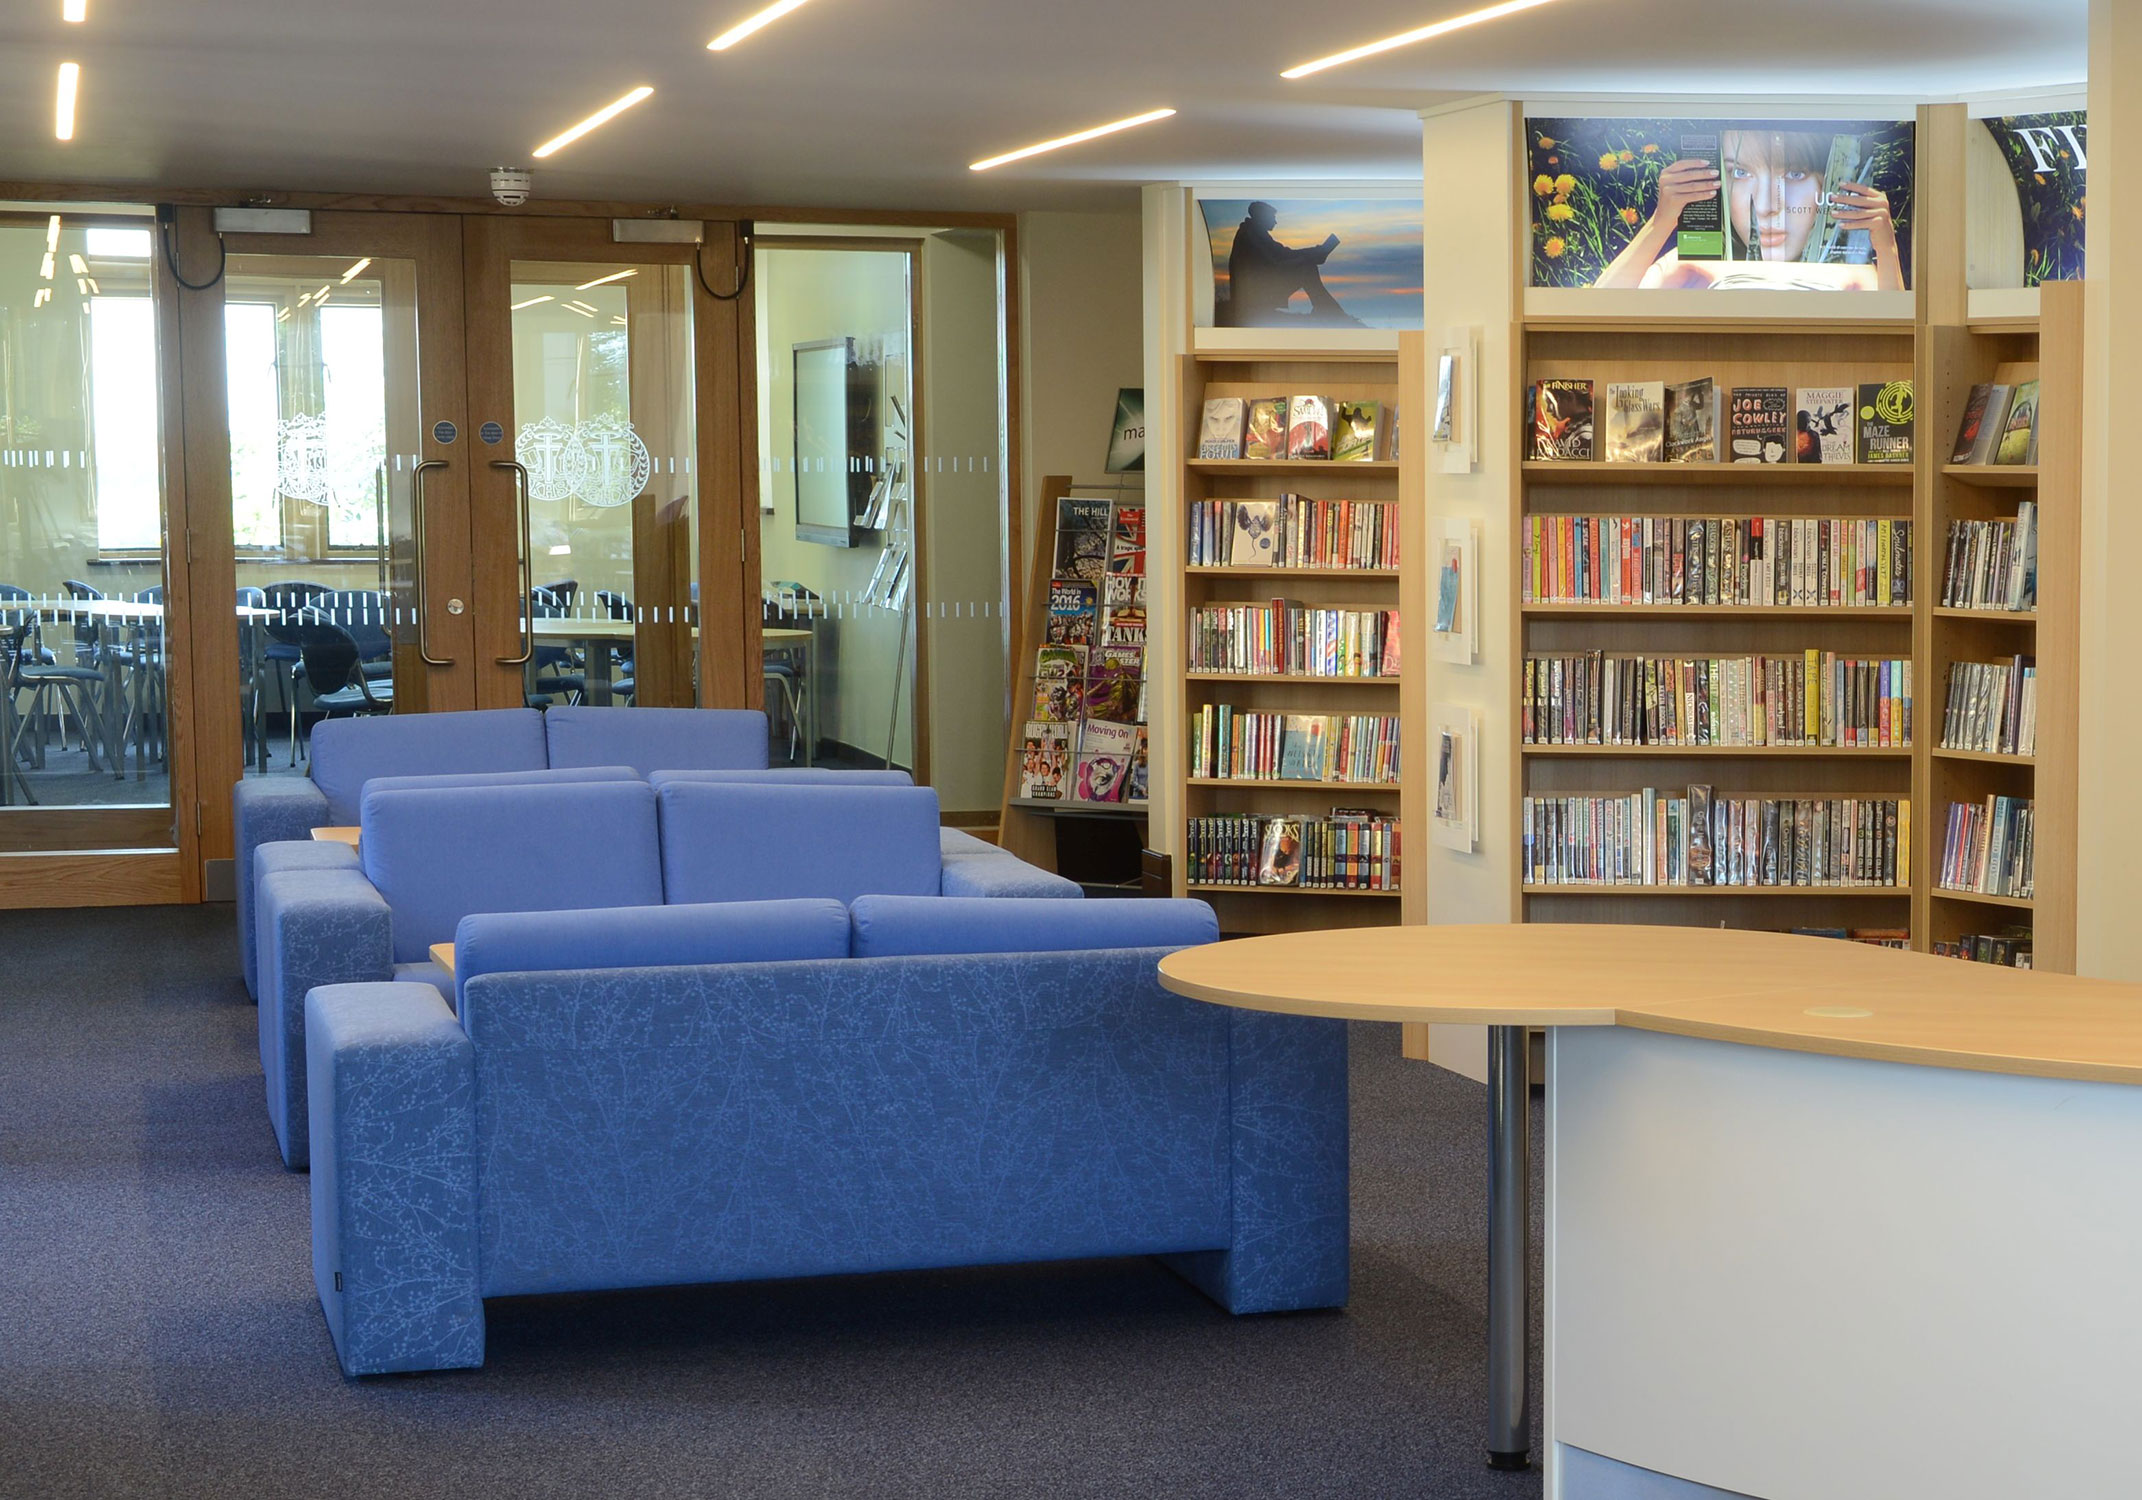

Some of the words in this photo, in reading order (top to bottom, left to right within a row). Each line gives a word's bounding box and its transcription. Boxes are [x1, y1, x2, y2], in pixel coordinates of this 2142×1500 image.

[1551, 381, 1588, 390] FINISHER
[1615, 385, 1644, 403] Looking
[1806, 391, 1844, 399] MAGGIE
[1642, 398, 1661, 412] Wars
[1733, 398, 1762, 412] JOE
[1732, 411, 1787, 425] COWLEY
[1863, 425, 1890, 438] MAZE
[1822, 443, 1851, 453] DREAM
[1870, 437, 1910, 450] RUNNER
[1823, 452, 1852, 461] THIEVES
[1073, 507, 1090, 516] THE
[1091, 507, 1108, 516] HILL
[1724, 525, 1732, 552] ASHES
[1892, 528, 1905, 577] Soulmates
[1050, 595, 1081, 611] 2016
[1104, 649, 1135, 658] GAMES
[1807, 656, 1817, 685] TAPE
[1087, 724, 1117, 739] Moving
[1117, 728, 1129, 739] On
